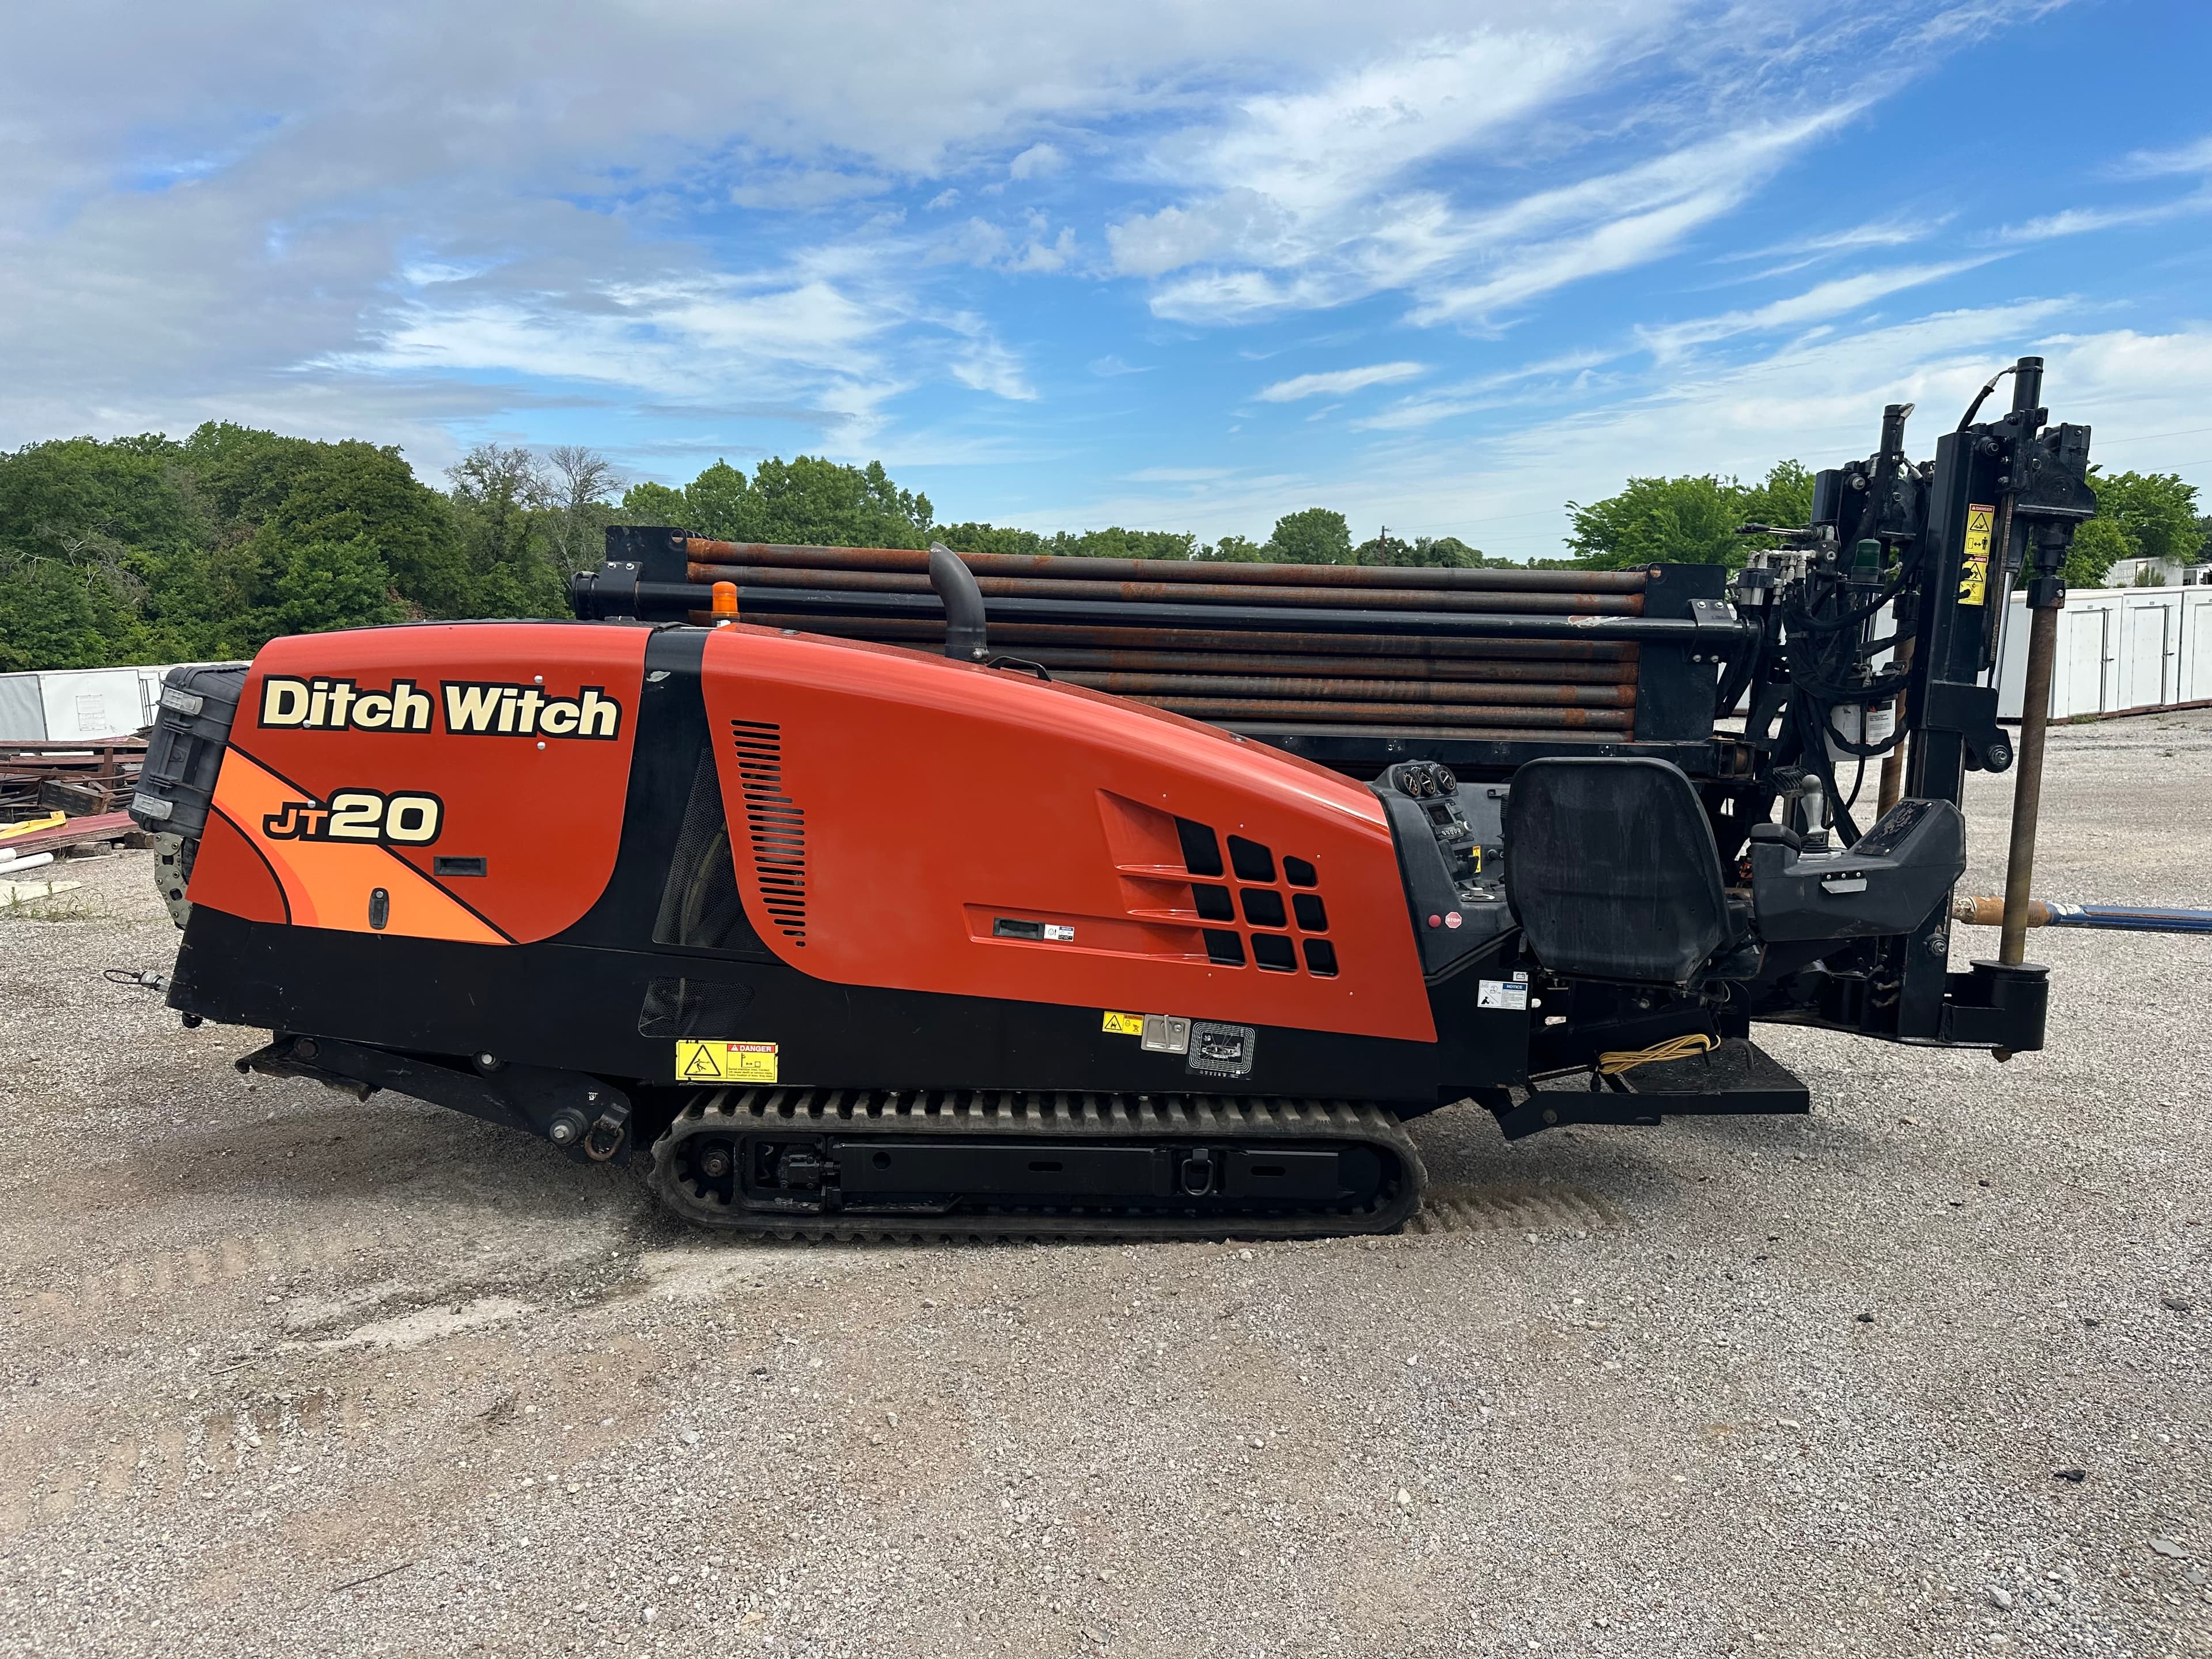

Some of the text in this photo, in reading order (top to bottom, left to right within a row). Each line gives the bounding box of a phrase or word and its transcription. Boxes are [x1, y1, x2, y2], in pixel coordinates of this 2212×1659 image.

[262, 678, 619, 737] Ditch Witch
[268, 793, 439, 842] JT20
